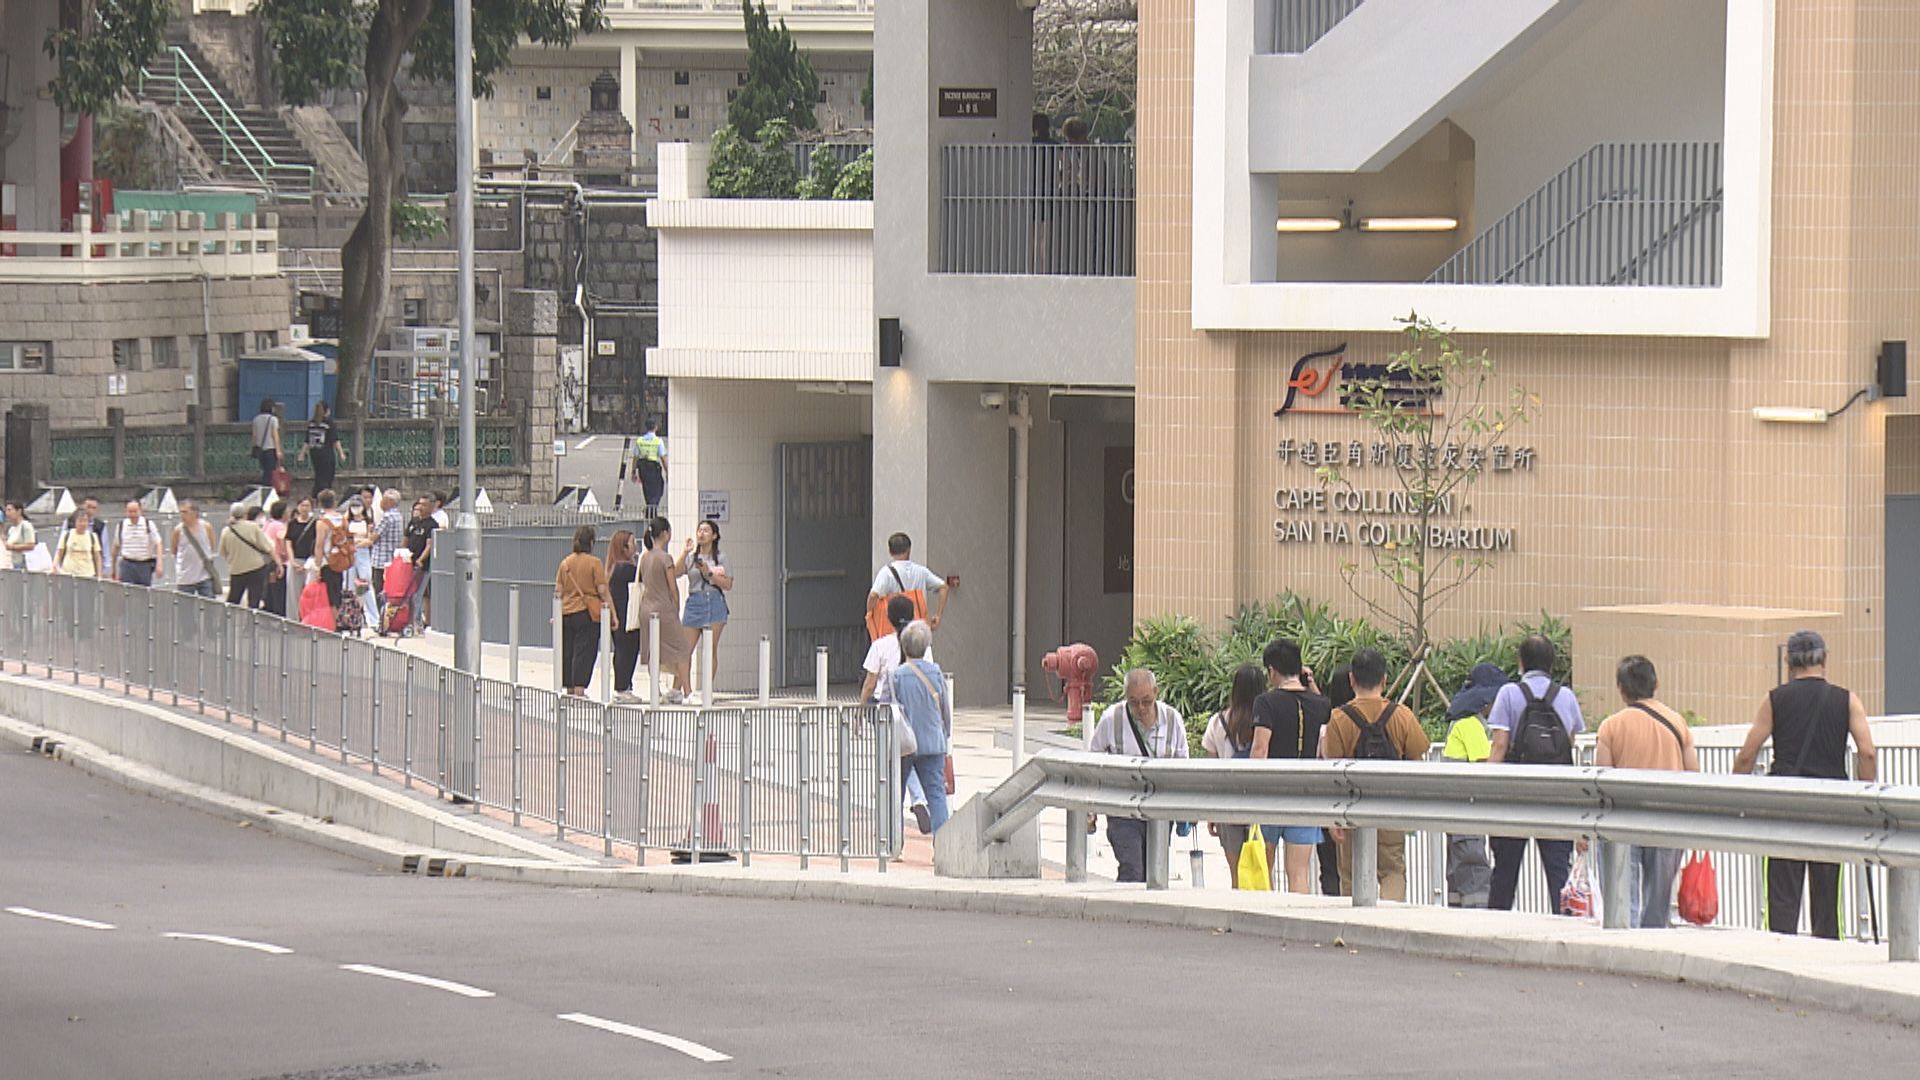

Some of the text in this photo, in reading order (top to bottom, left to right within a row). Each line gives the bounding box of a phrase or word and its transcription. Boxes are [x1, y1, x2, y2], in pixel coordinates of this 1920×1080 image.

[1274, 488, 1325, 512] CAPE
[1273, 518, 1313, 543] SAN
[1321, 521, 1350, 544] HA
